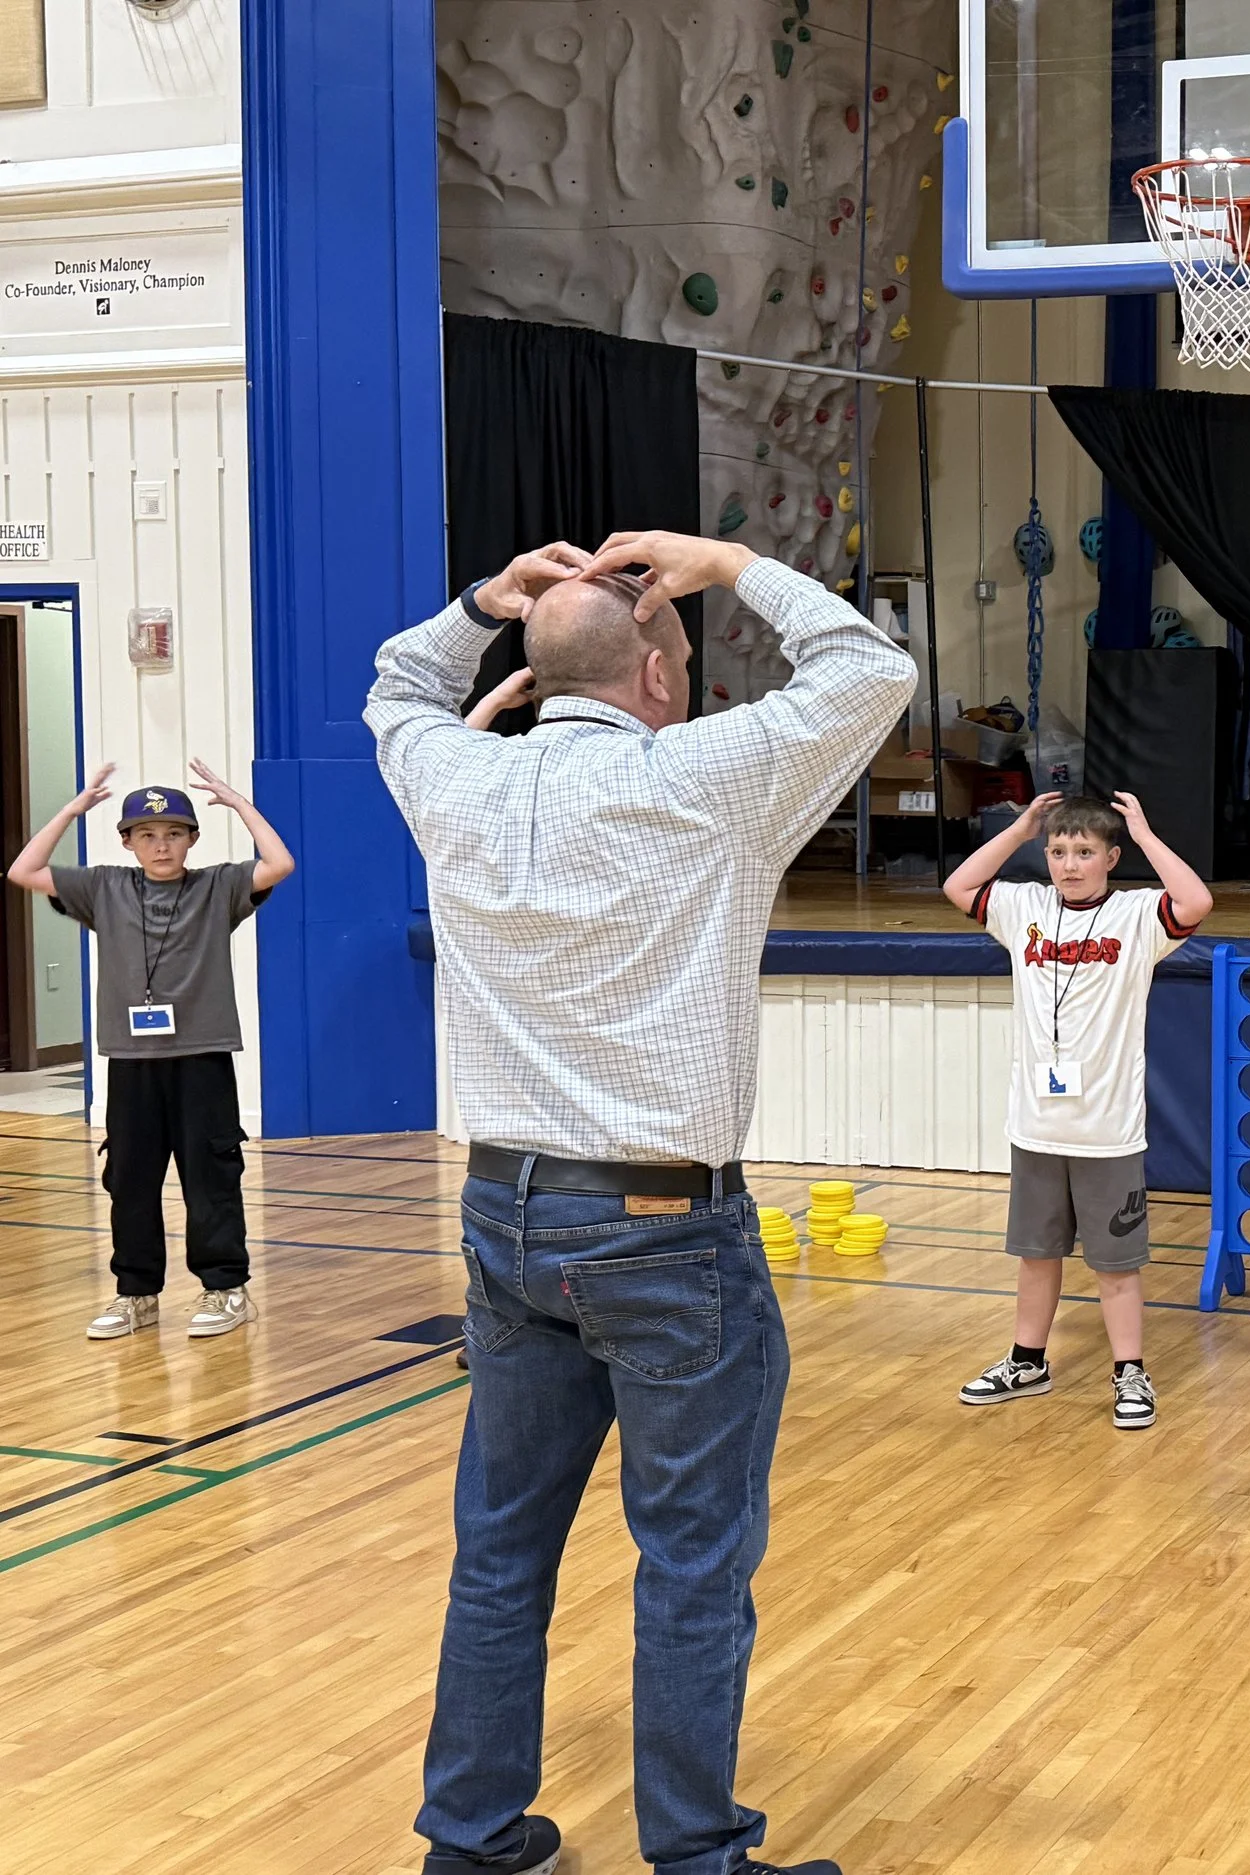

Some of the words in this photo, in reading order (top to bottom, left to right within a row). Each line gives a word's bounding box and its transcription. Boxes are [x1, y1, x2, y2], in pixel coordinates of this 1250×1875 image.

[55, 259, 96, 274] Dennis
[100, 257, 151, 273] Maloney
[5, 281, 76, 298] Co-Founder,
[79, 279, 139, 294] Visionary,
[143, 273, 205, 290] Champion
[0, 525, 45, 539] HEALTH
[0, 543, 40, 557] OFFICE
[1024, 922, 1121, 968] Angels
